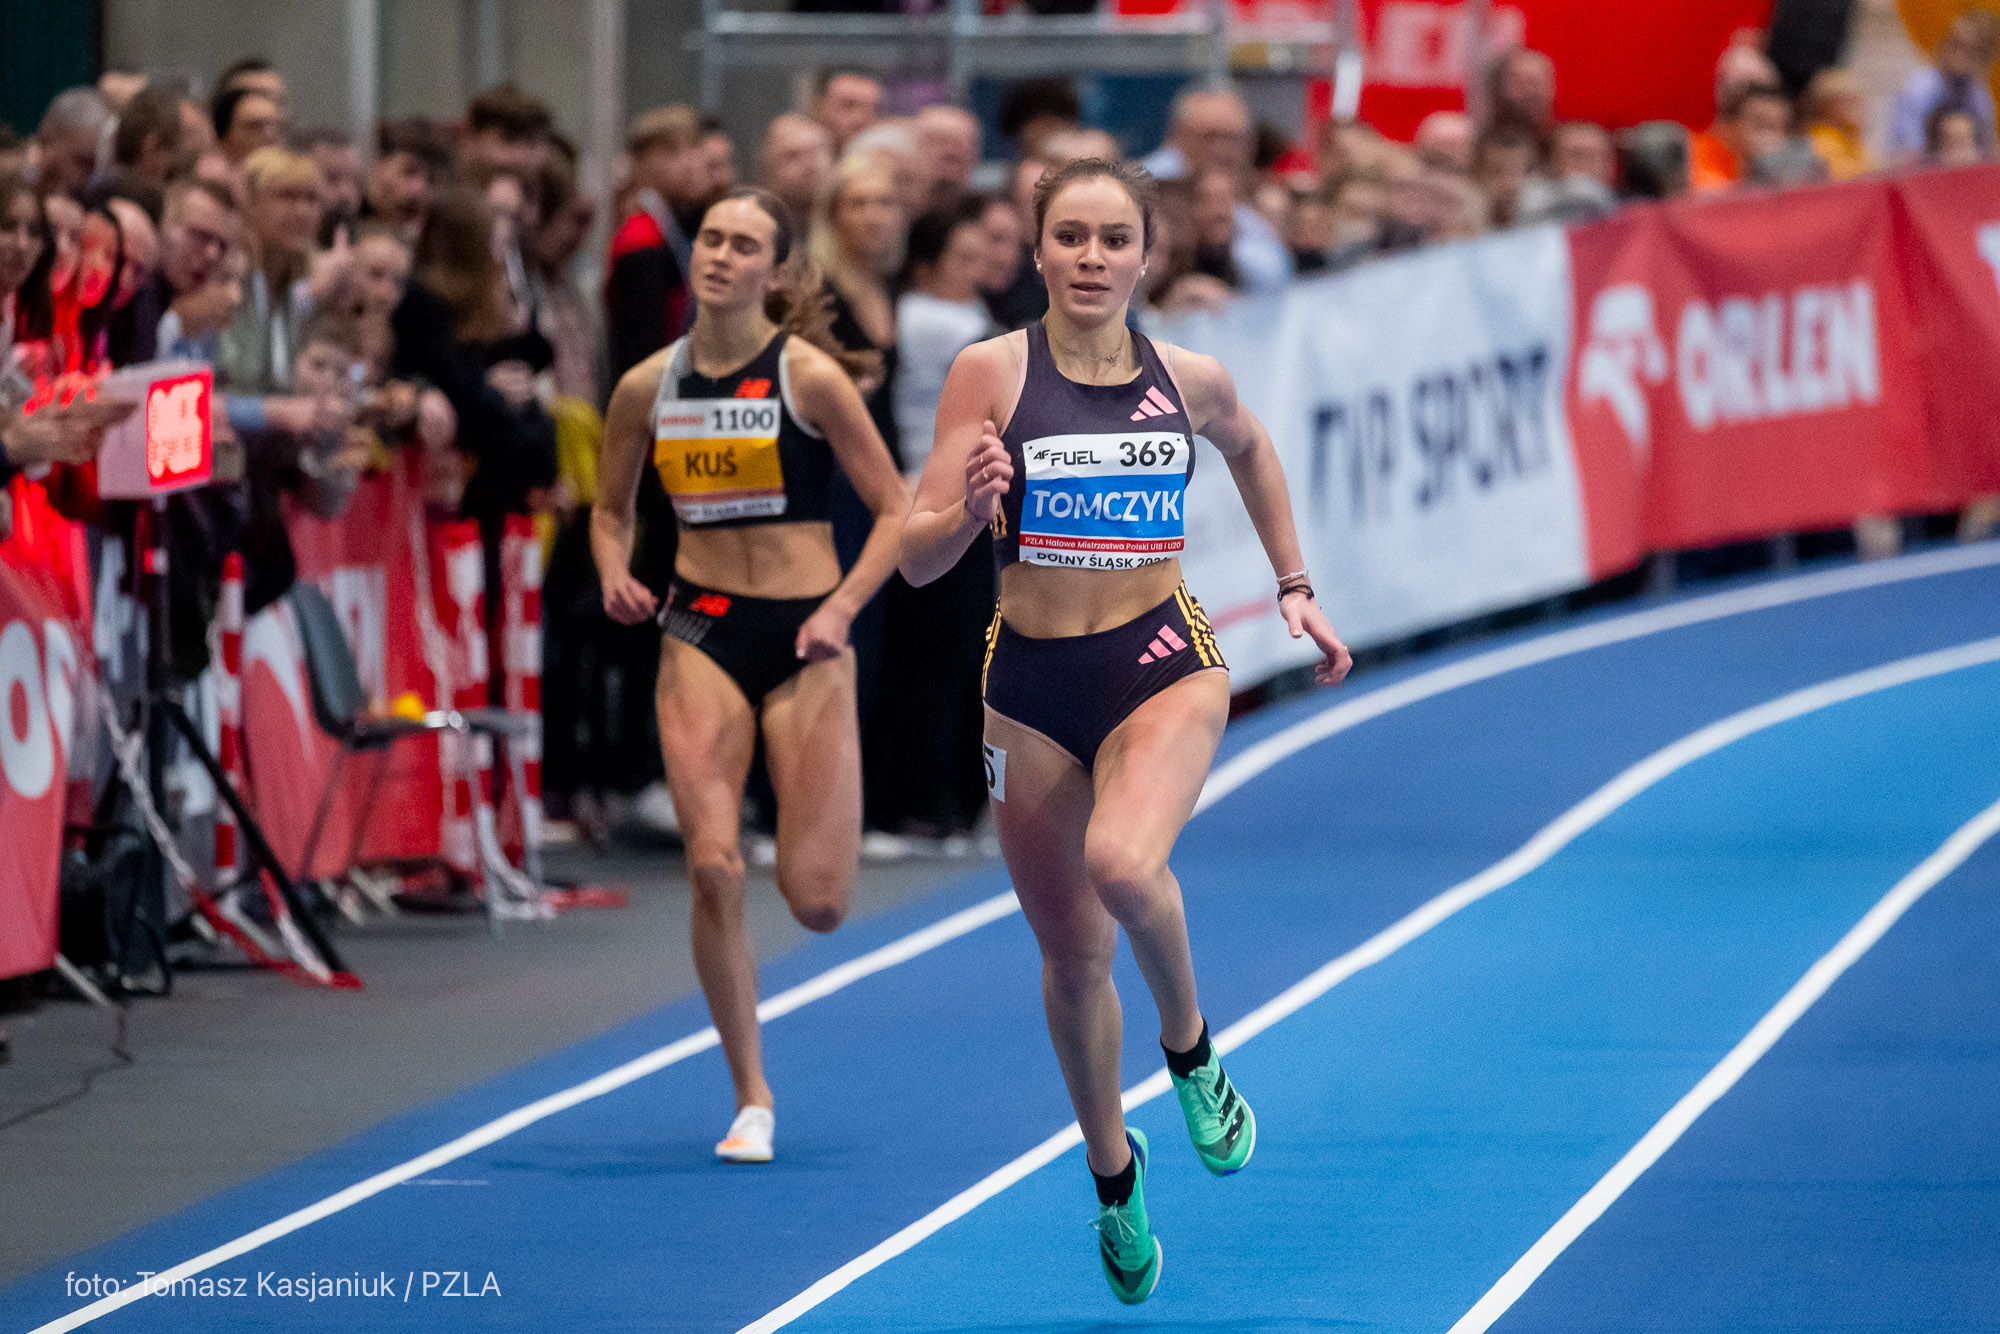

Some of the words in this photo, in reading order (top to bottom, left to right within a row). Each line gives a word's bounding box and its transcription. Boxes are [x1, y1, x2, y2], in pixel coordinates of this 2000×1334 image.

[1676, 279, 1882, 430] ORLEN
[713, 409, 774, 431] 1100
[1410, 345, 1550, 510] SPORT
[686, 447, 737, 477] KUŚ
[1051, 451, 1101, 466] FUEL
[1119, 441, 1175, 467] 369
[1032, 490, 1180, 522] TOMCZYK
[1025, 537, 1044, 545] PZLA
[1045, 539, 1075, 548] Halowe
[1078, 541, 1124, 550] Mistrzostwa
[1126, 543, 1149, 551] Polski
[1168, 541, 1181, 549] U20
[1037, 552, 1086, 566] DOLNY
[1089, 553, 1133, 569] ŚLĄSK
